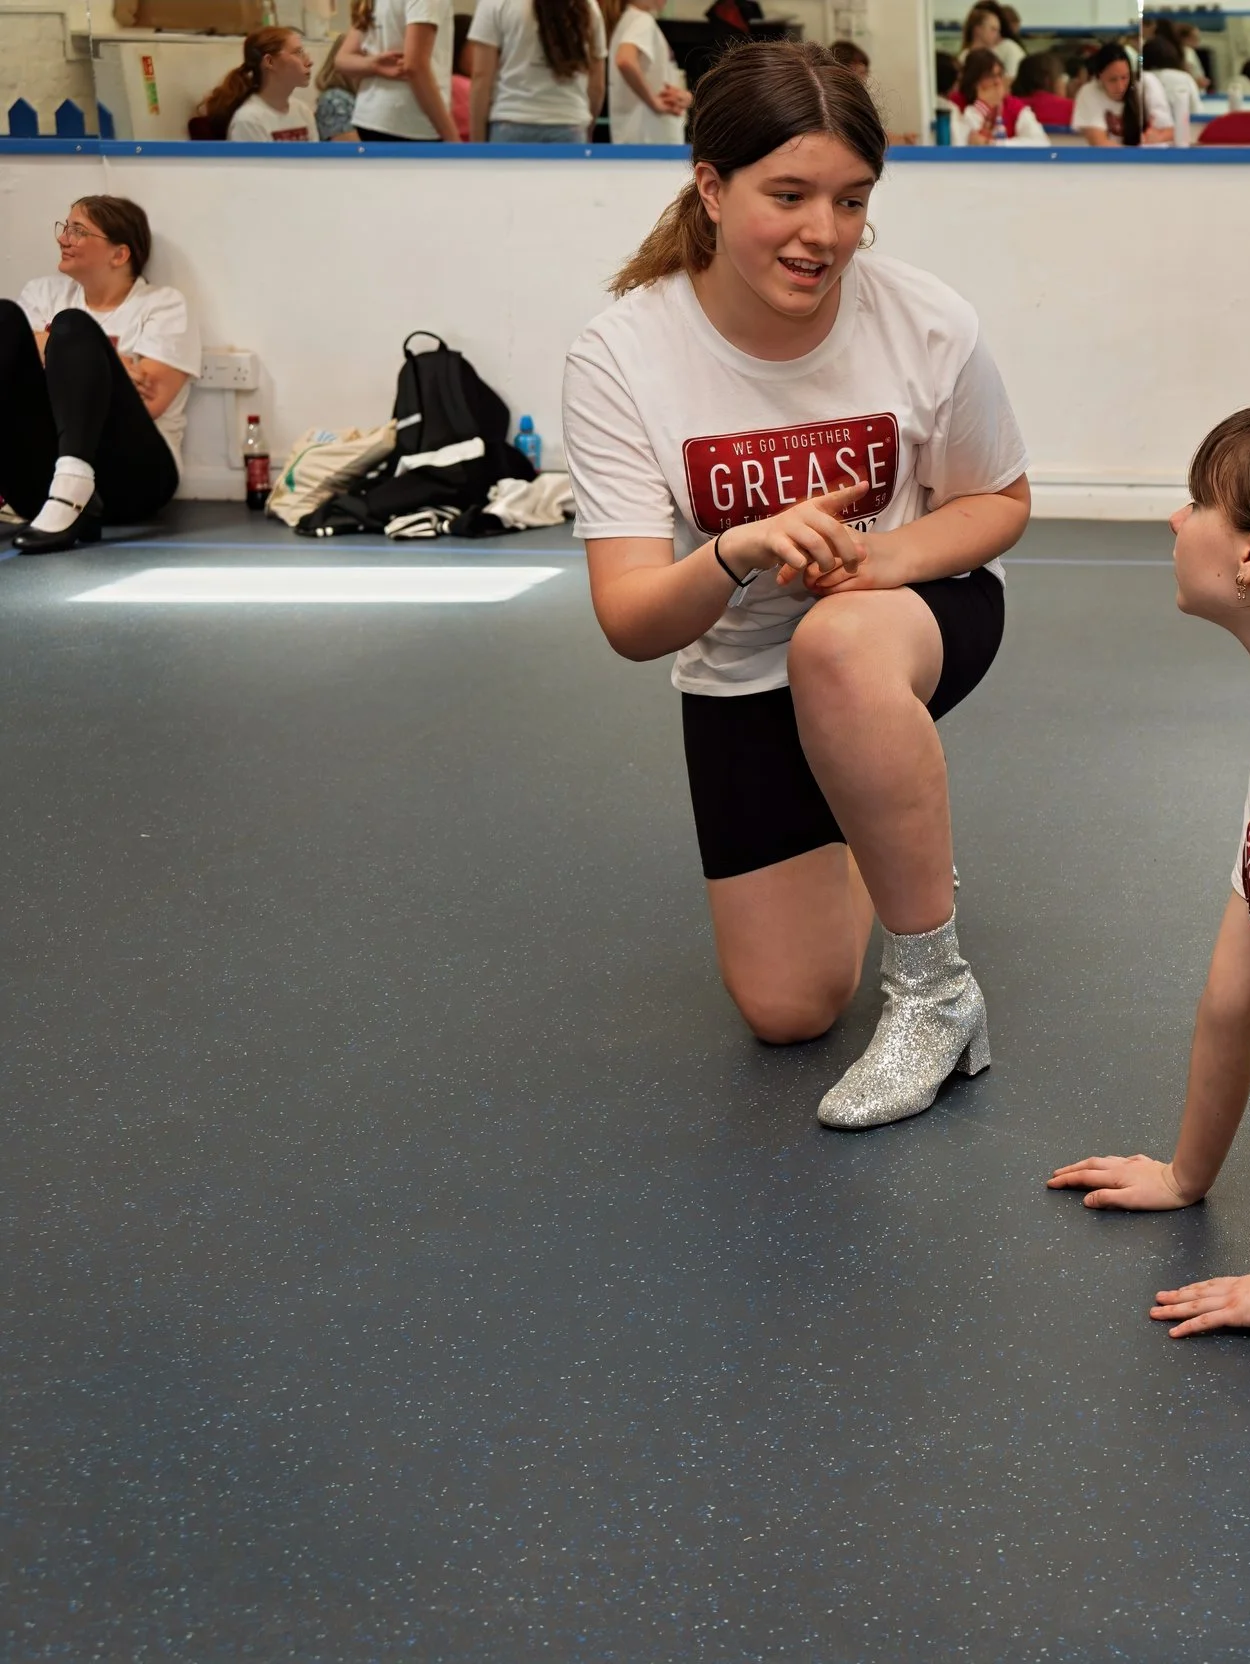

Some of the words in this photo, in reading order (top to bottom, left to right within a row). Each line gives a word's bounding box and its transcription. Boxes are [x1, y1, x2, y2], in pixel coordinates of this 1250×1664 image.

[733, 441, 753, 456] WE
[759, 438, 776, 452] GO
[782, 428, 851, 450] TOGETHER
[709, 442, 887, 512] GREASE
[719, 517, 732, 529] 19
